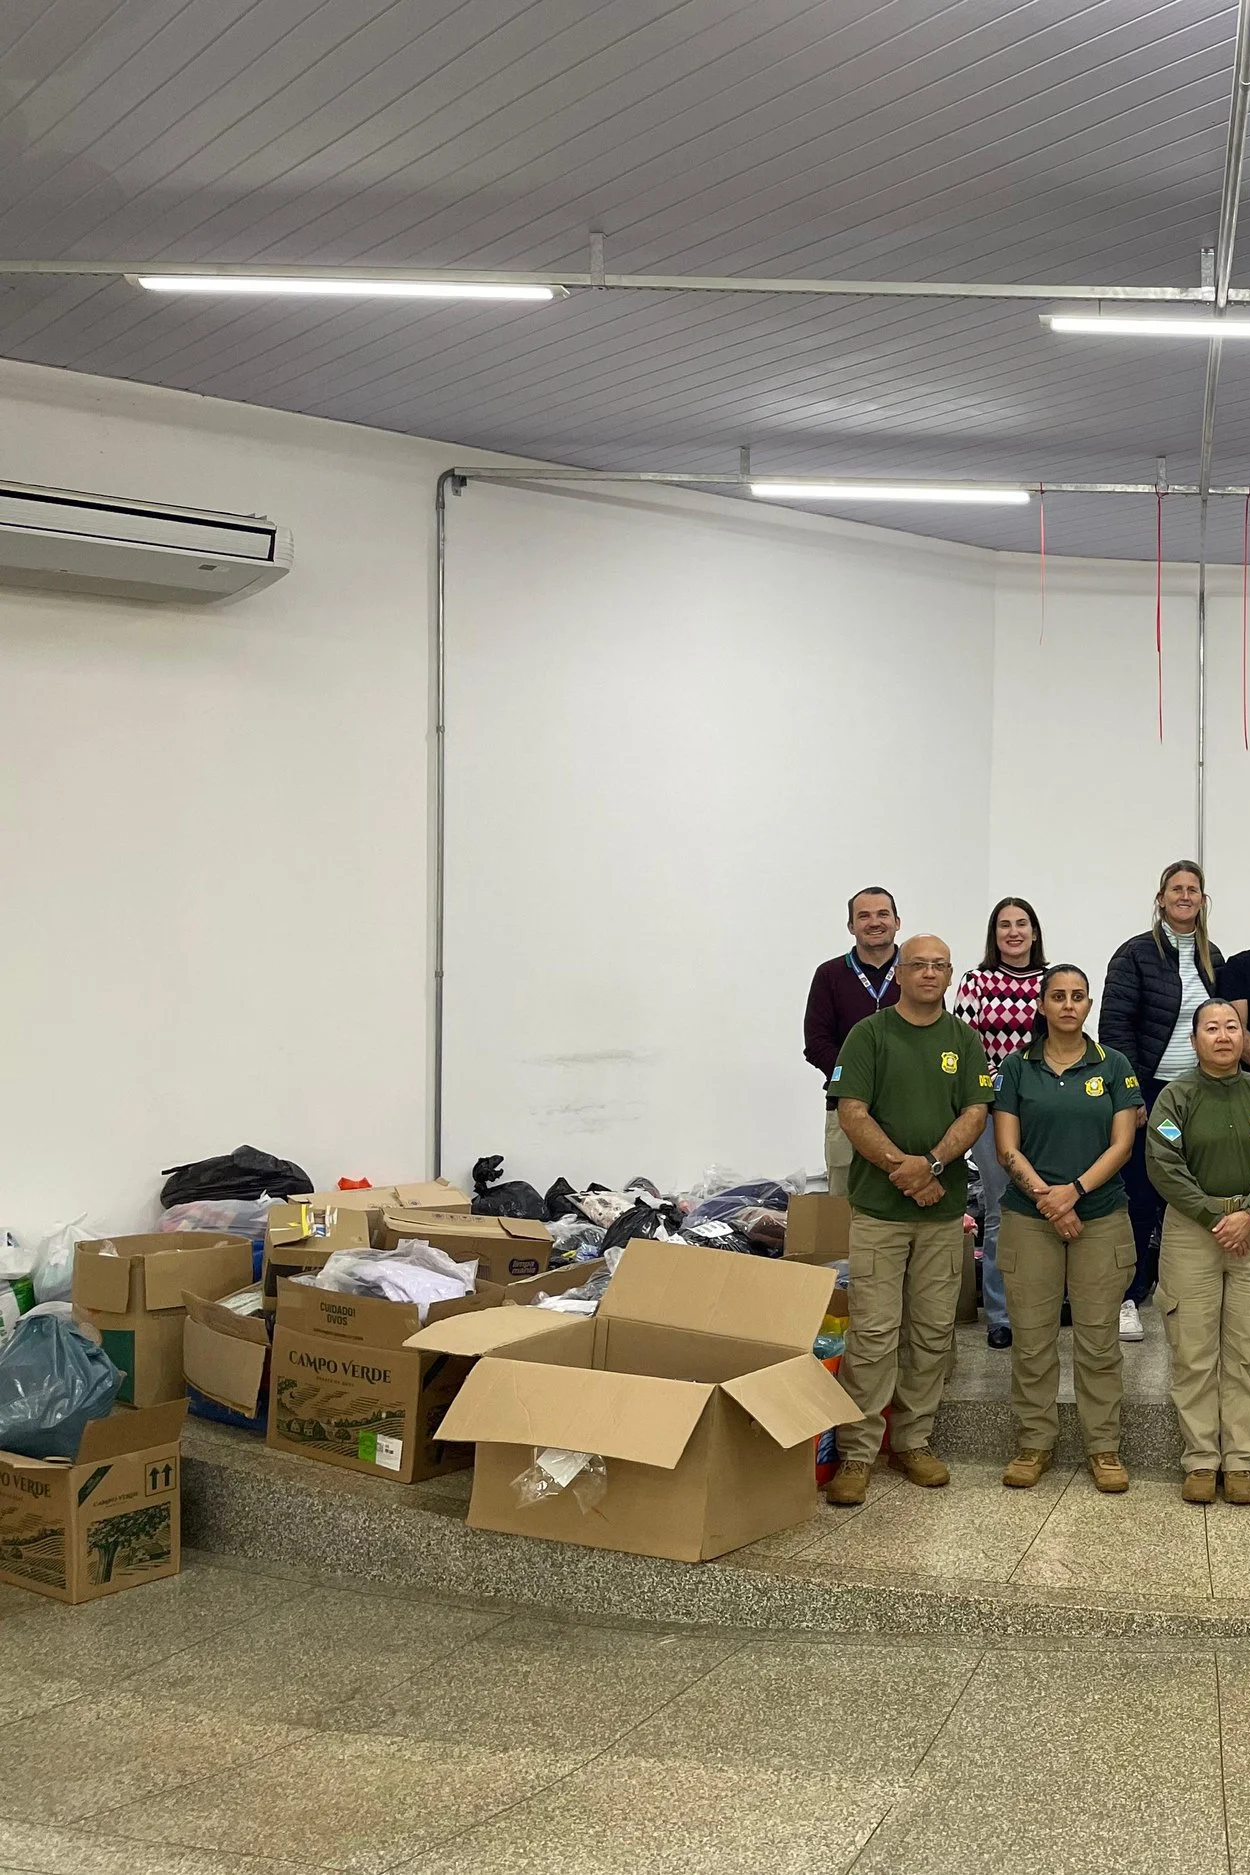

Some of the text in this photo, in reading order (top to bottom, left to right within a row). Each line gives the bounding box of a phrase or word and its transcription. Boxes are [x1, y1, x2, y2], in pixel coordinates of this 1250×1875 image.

[320, 1302, 356, 1318] CUIDADO!
[327, 1313, 348, 1326] OVOS
[289, 1350, 338, 1374] CAMPO
[341, 1360, 392, 1385] VERDE
[13, 1473, 52, 1499] VERDE
